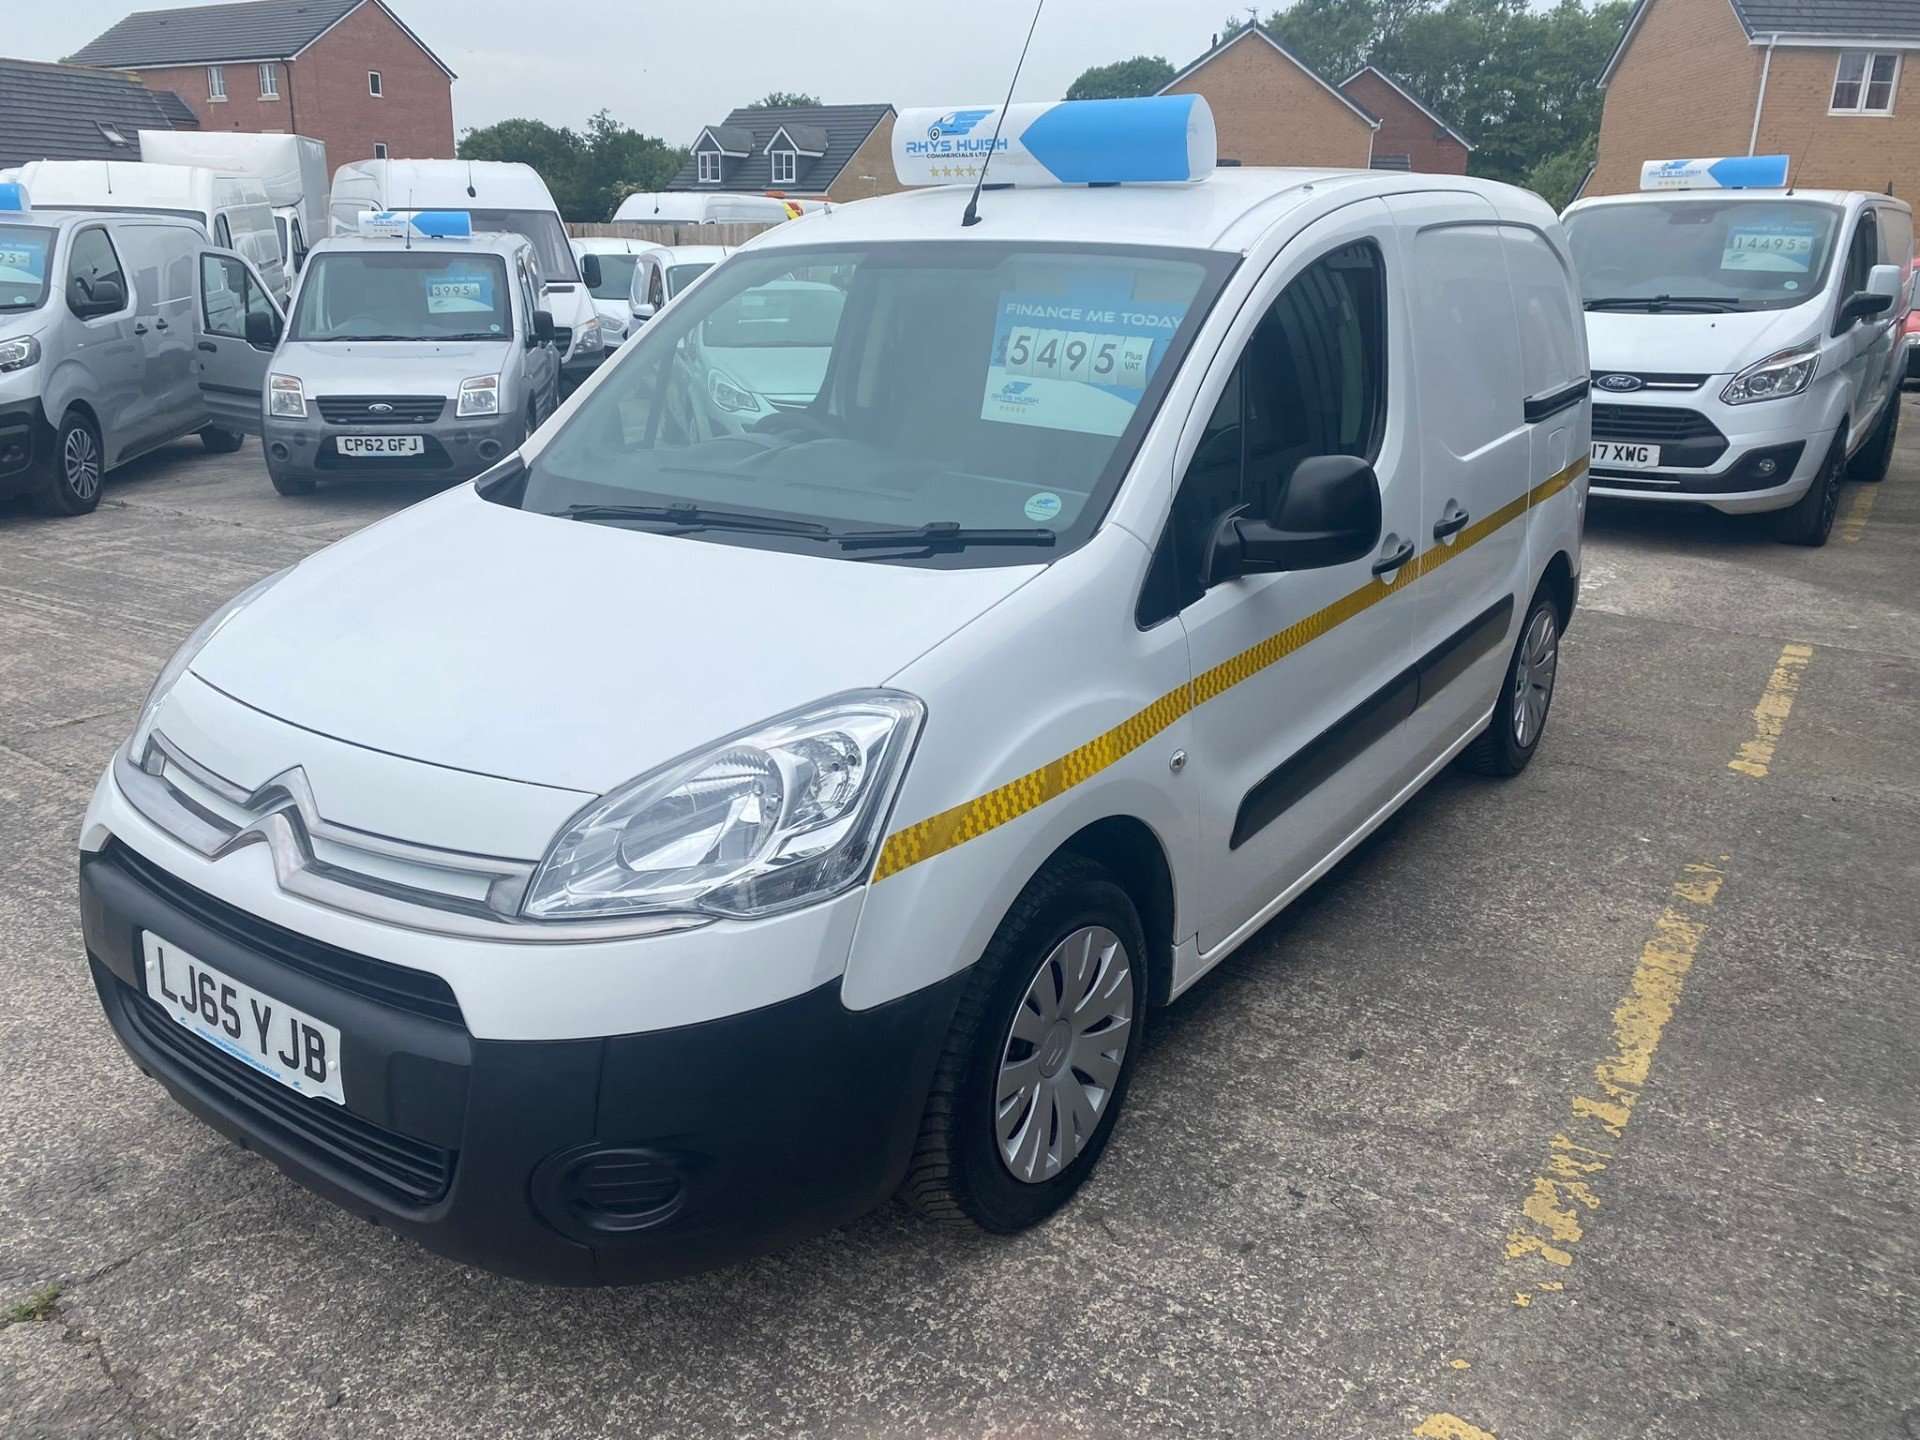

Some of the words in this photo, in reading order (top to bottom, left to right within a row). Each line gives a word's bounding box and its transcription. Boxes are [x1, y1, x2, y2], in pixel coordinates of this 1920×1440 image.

[906, 140, 951, 153] RHYS
[957, 138, 1008, 151] HUISH
[1736, 237, 1797, 250] 14495
[434, 286, 470, 297] 3995
[1006, 303, 1082, 321] FINANCE
[1086, 309, 1116, 322] ME
[1120, 312, 1185, 328] TODAY
[1009, 335, 1117, 374] 5495
[1124, 351, 1143, 361] Plus
[1124, 361, 1141, 371] VAT
[1606, 376, 1632, 387] Ford
[344, 438, 384, 452] CP62
[388, 438, 418, 451] GFJ
[1613, 445, 1648, 462] XWG
[157, 947, 241, 1039] LJ65
[250, 997, 327, 1084] YJB
